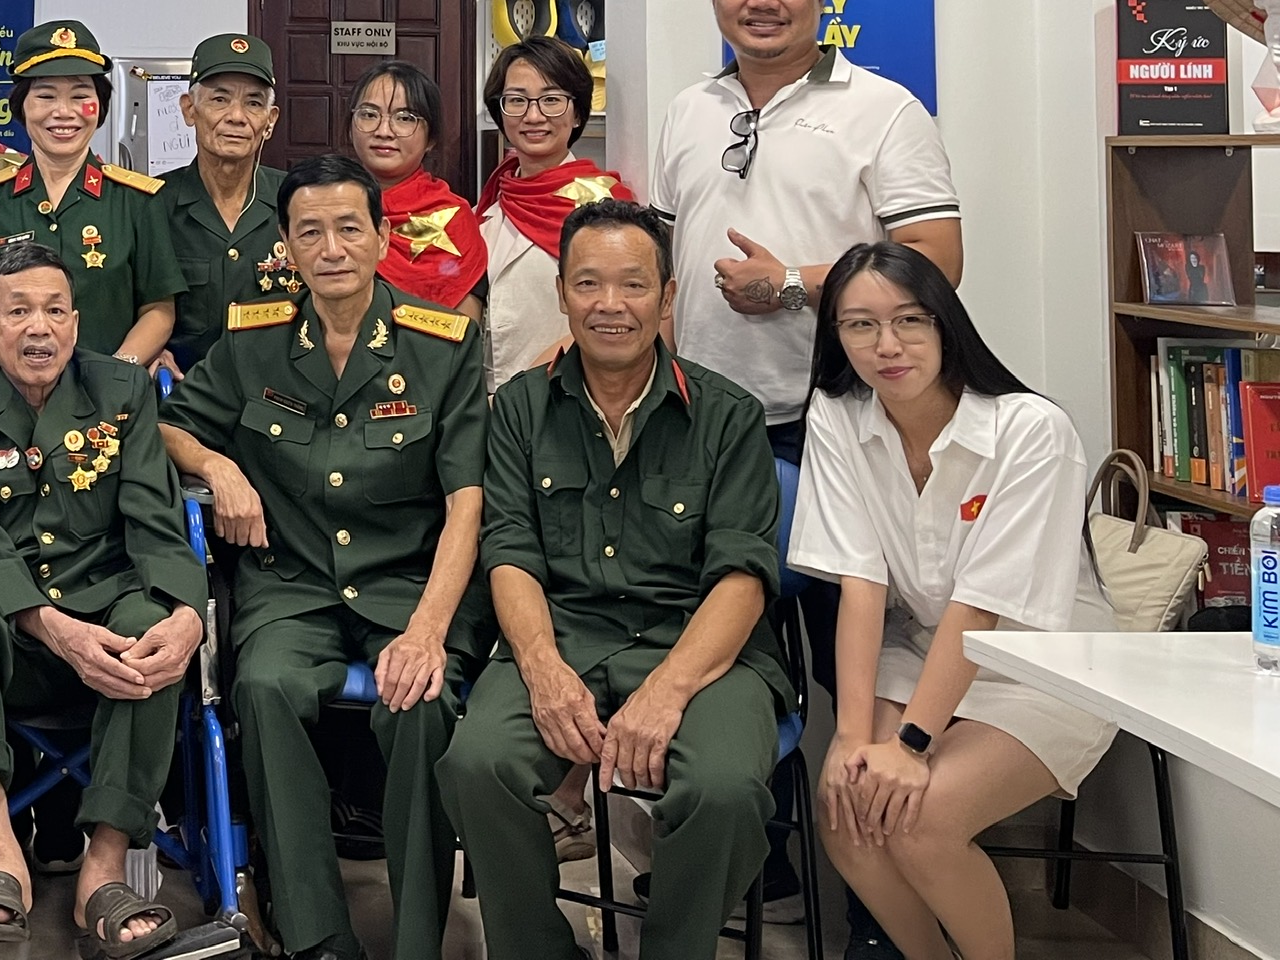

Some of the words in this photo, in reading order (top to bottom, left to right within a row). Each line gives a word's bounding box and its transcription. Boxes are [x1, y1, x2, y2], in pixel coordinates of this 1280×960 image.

[333, 27, 362, 37] STAFF
[365, 28, 392, 37] ONLY
[817, 16, 861, 48] ẦY
[1142, 27, 1188, 58] Ký
[1129, 62, 1176, 79] NGƯỜI
[1180, 61, 1213, 79] LÍNH
[1263, 590, 1279, 629] KIM
